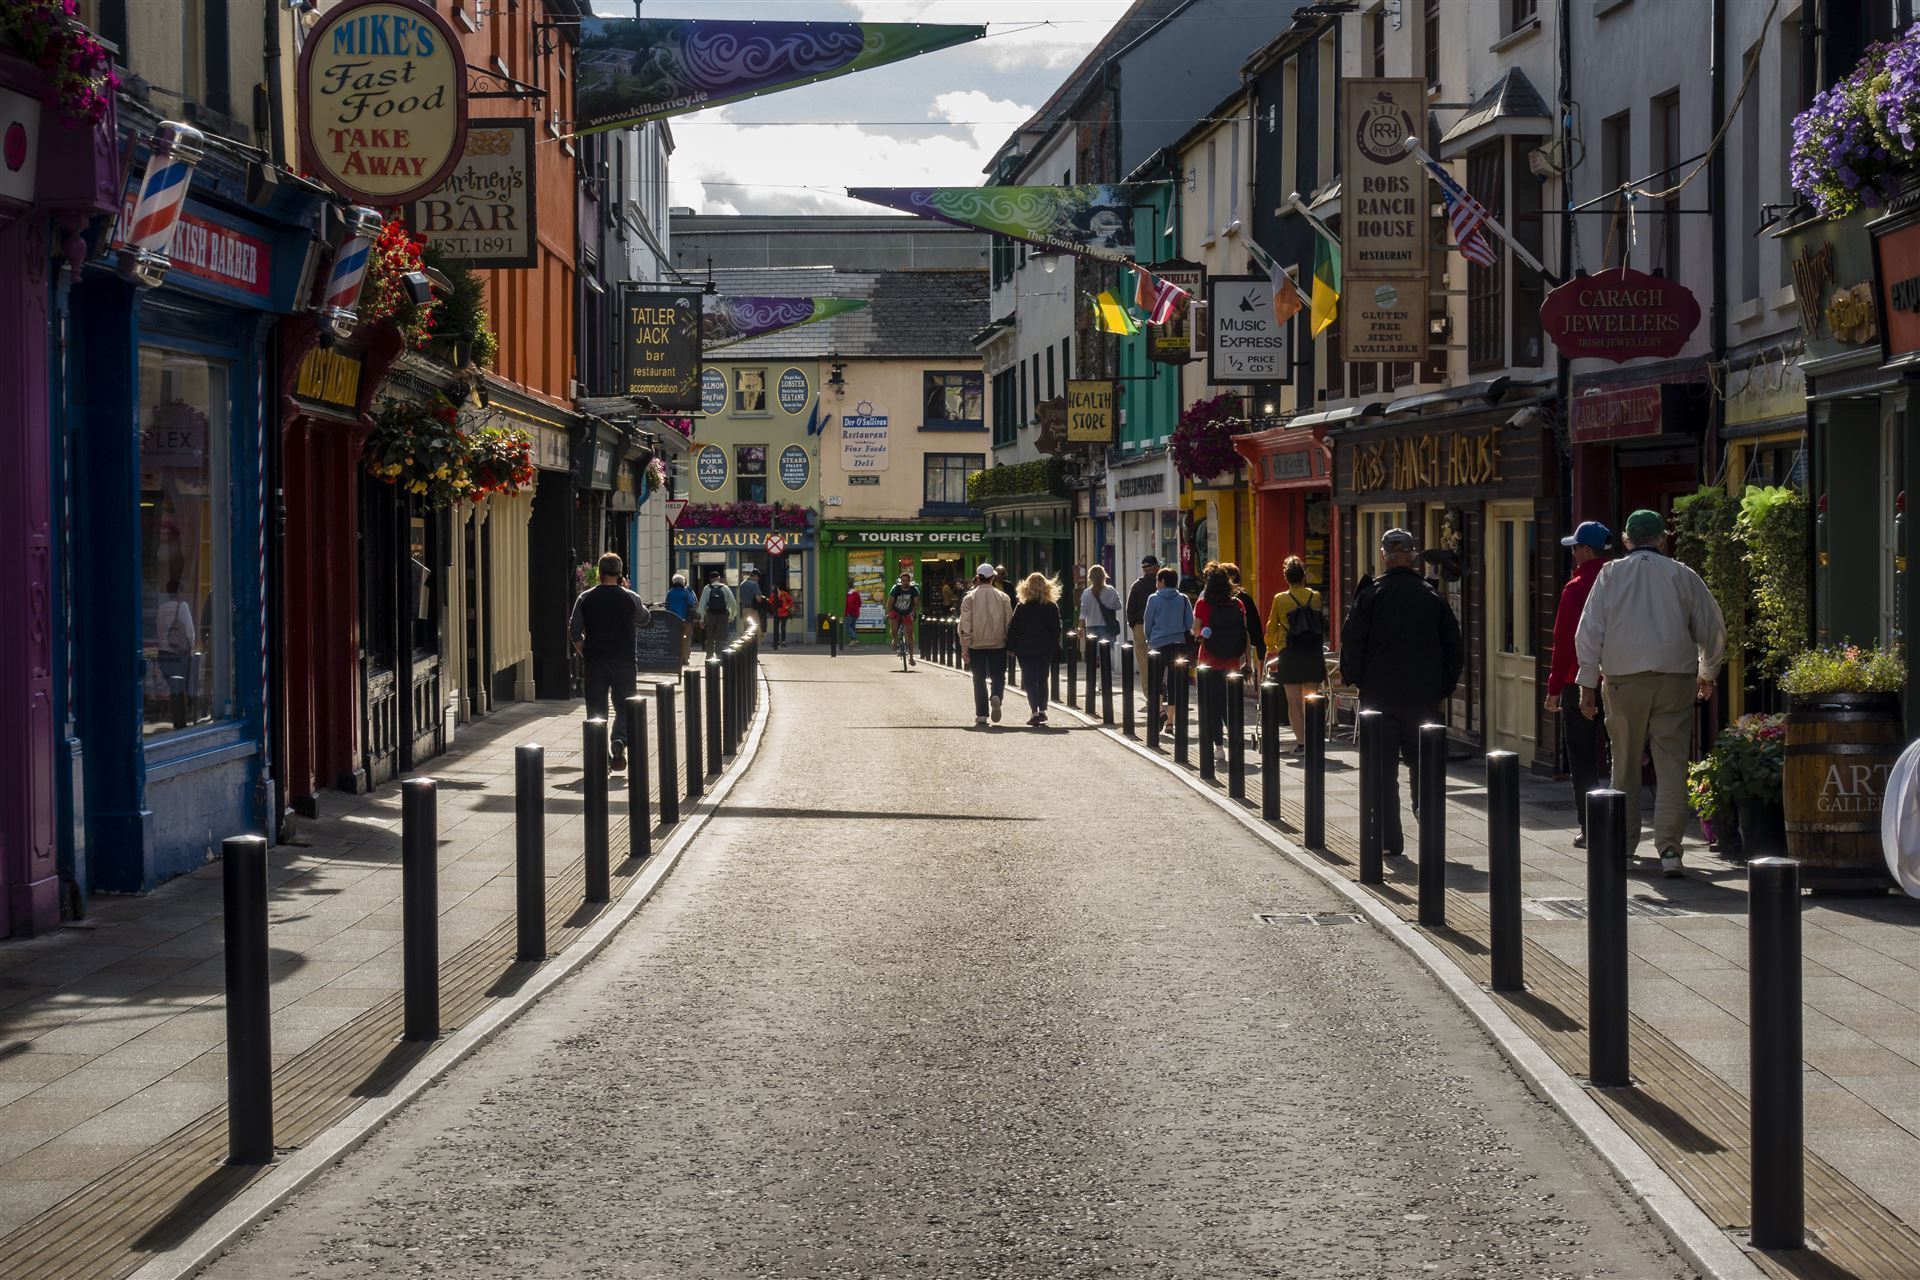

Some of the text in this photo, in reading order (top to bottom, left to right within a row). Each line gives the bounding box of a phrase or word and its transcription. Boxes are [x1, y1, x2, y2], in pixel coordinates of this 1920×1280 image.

[333, 14, 434, 58] MIKE'S
[320, 61, 416, 95] Fast
[338, 85, 445, 123] Food
[591, 90, 709, 127] www.killarney.ie
[1374, 123, 1397, 139] RRH
[328, 127, 410, 153] TAKE
[341, 150, 428, 177] AWAY
[1363, 176, 1410, 193] ROBS
[1357, 198, 1415, 216] RANCH
[420, 200, 520, 231] BAR
[1357, 220, 1416, 237] HOUSE
[1026, 229, 1045, 242] The
[1046, 234, 1073, 250] Town
[1073, 241, 1084, 252] in
[210, 231, 257, 285] BARBER
[1359, 251, 1412, 261] RESTAURANT
[1579, 289, 1664, 308] CARAGH
[631, 307, 676, 325] TATLER
[1361, 311, 1409, 320] GLUTEN
[1220, 318, 1266, 331] MUSIC
[1371, 323, 1401, 331] FREE
[1562, 314, 1680, 335] JEWELLERS
[636, 327, 670, 344] JACK
[1220, 335, 1282, 348] EXPRESS
[1368, 334, 1403, 342] MENU
[1578, 337, 1663, 348] IRISH JEWELLERY
[646, 350, 665, 361] bar
[1352, 344, 1418, 353] AVAILABLE
[1247, 355, 1277, 363] PRICE
[633, 367, 676, 377] restaurant
[1249, 364, 1274, 372] CD'S
[629, 383, 678, 393] accommodation
[702, 382, 725, 390] ALMON
[781, 380, 805, 388] LOBSTER
[1068, 391, 1112, 409] HEALTH
[844, 416, 888, 427] Der O'Sullivan
[1072, 412, 1107, 430] STORE
[842, 430, 887, 439] Restaurant
[844, 444, 886, 453] Fine Foods
[854, 459, 874, 467] Deli
[1352, 425, 1504, 494] ROBS RANCH HOUSE
[859, 532, 981, 542] TOURIST OFFICE
[1819, 763, 1893, 796] ART
[1817, 797, 1882, 812] GALLE
